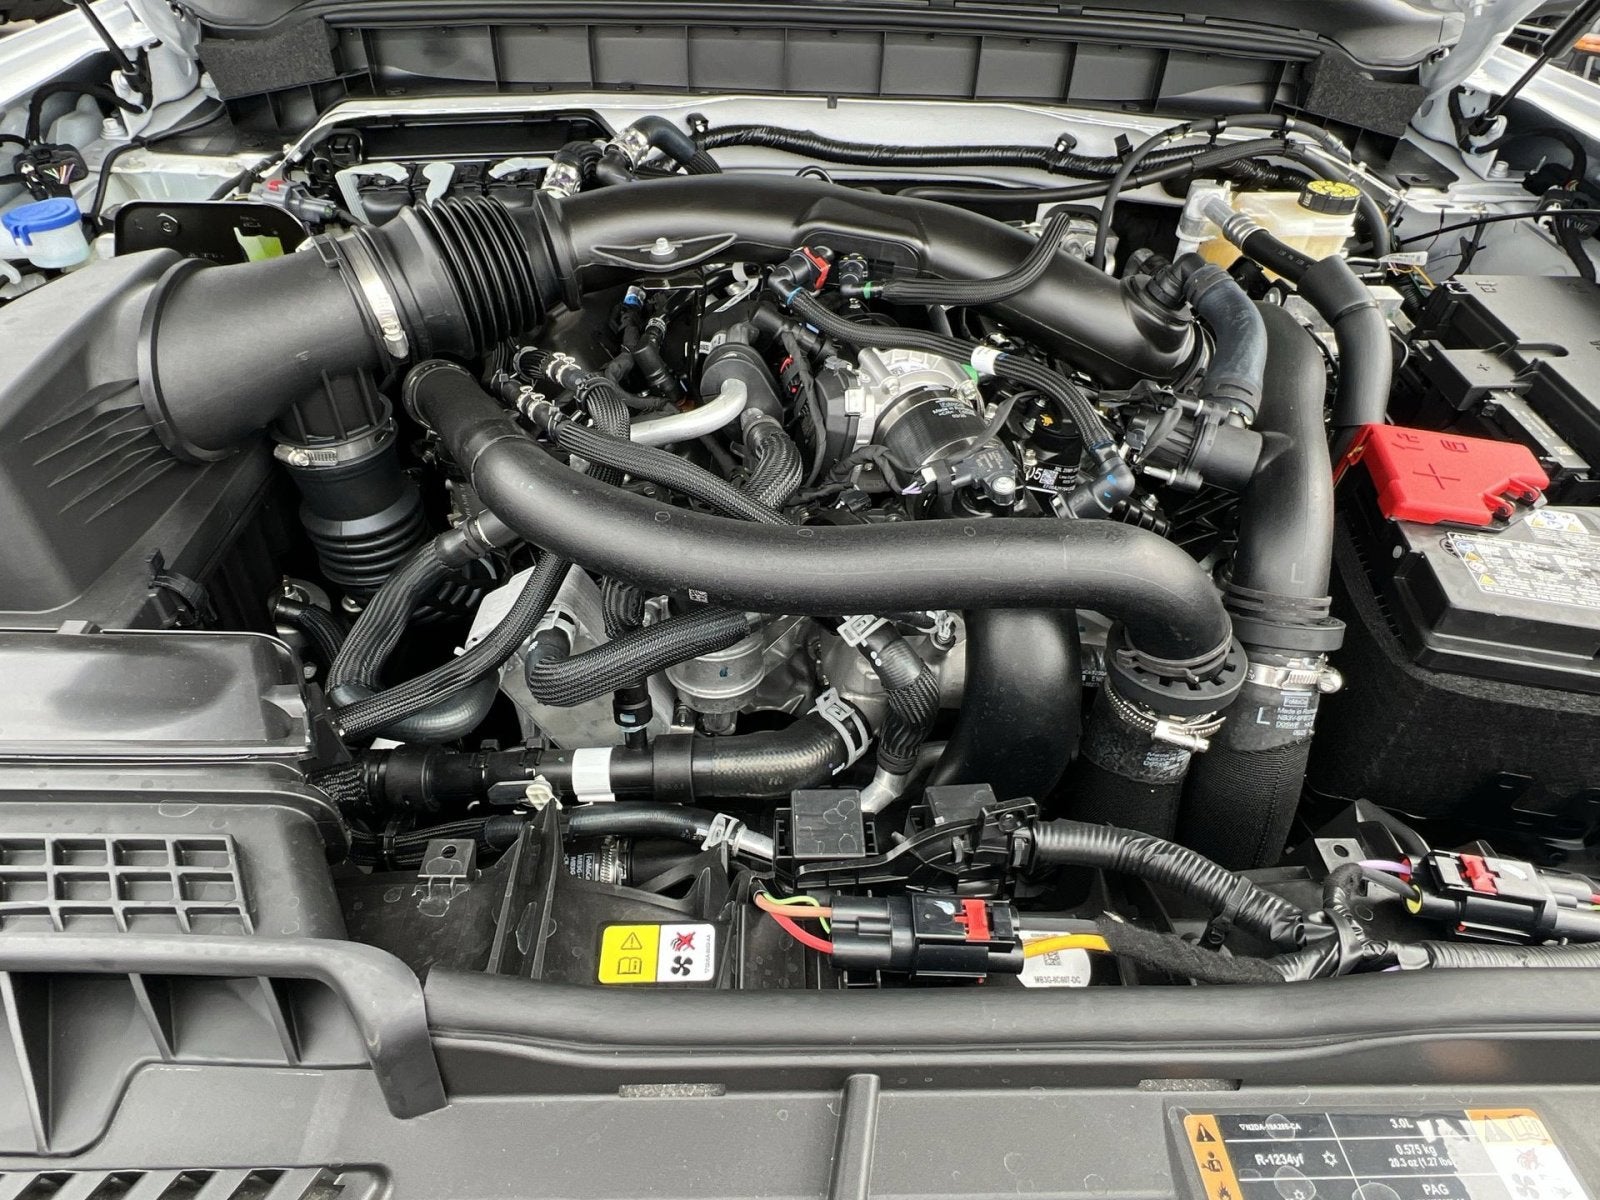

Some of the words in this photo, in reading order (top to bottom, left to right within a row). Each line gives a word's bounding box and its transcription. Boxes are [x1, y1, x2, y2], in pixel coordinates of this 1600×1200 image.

[1291, 562, 1305, 584] L
[1257, 706, 1271, 725] L
[1421, 1143, 1438, 1157] kg
[1422, 1183, 1450, 1196] PAG
